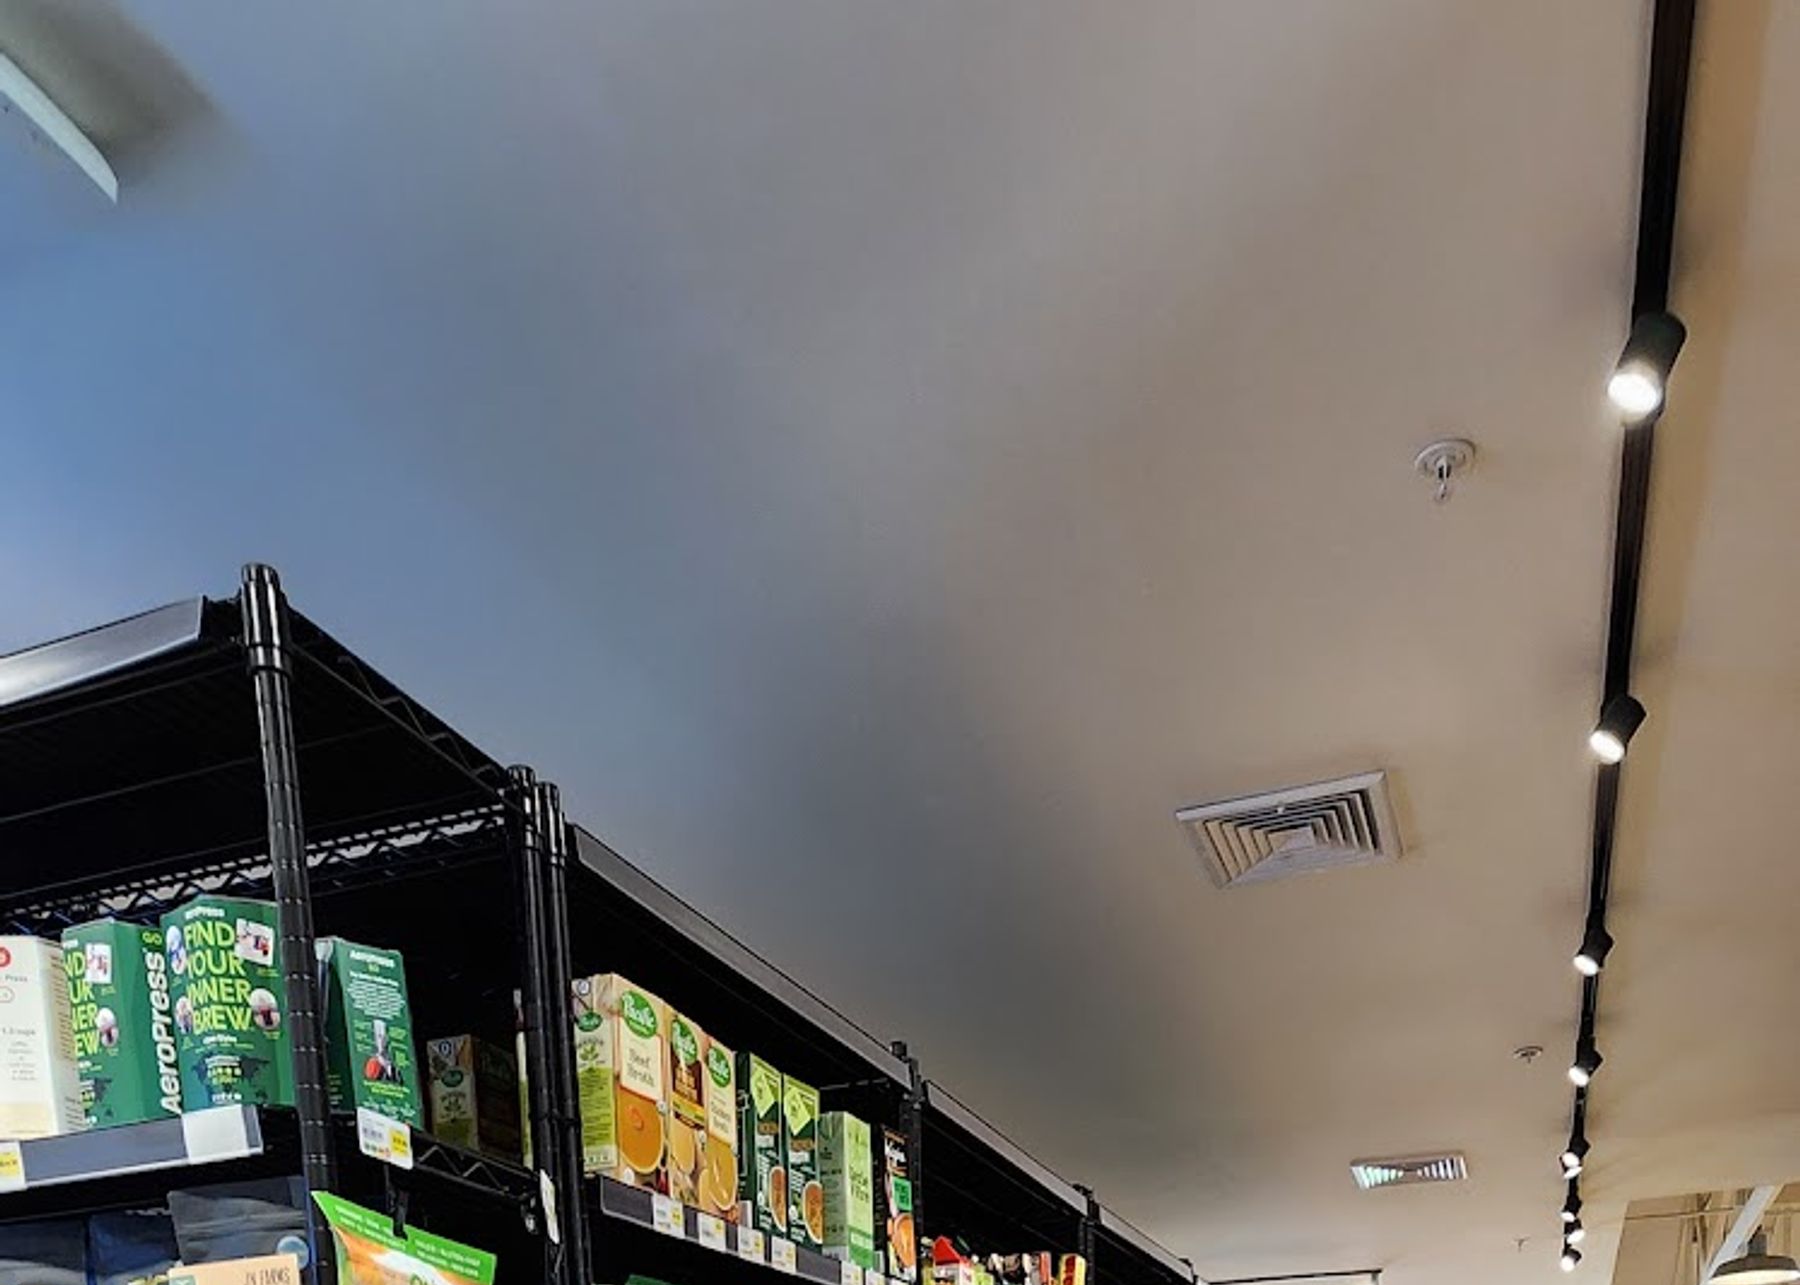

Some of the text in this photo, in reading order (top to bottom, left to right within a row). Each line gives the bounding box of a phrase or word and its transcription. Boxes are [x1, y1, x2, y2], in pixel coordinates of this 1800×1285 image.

[183, 920, 236, 948] FIND
[186, 950, 247, 979] YOUR
[187, 978, 252, 1008] INNER
